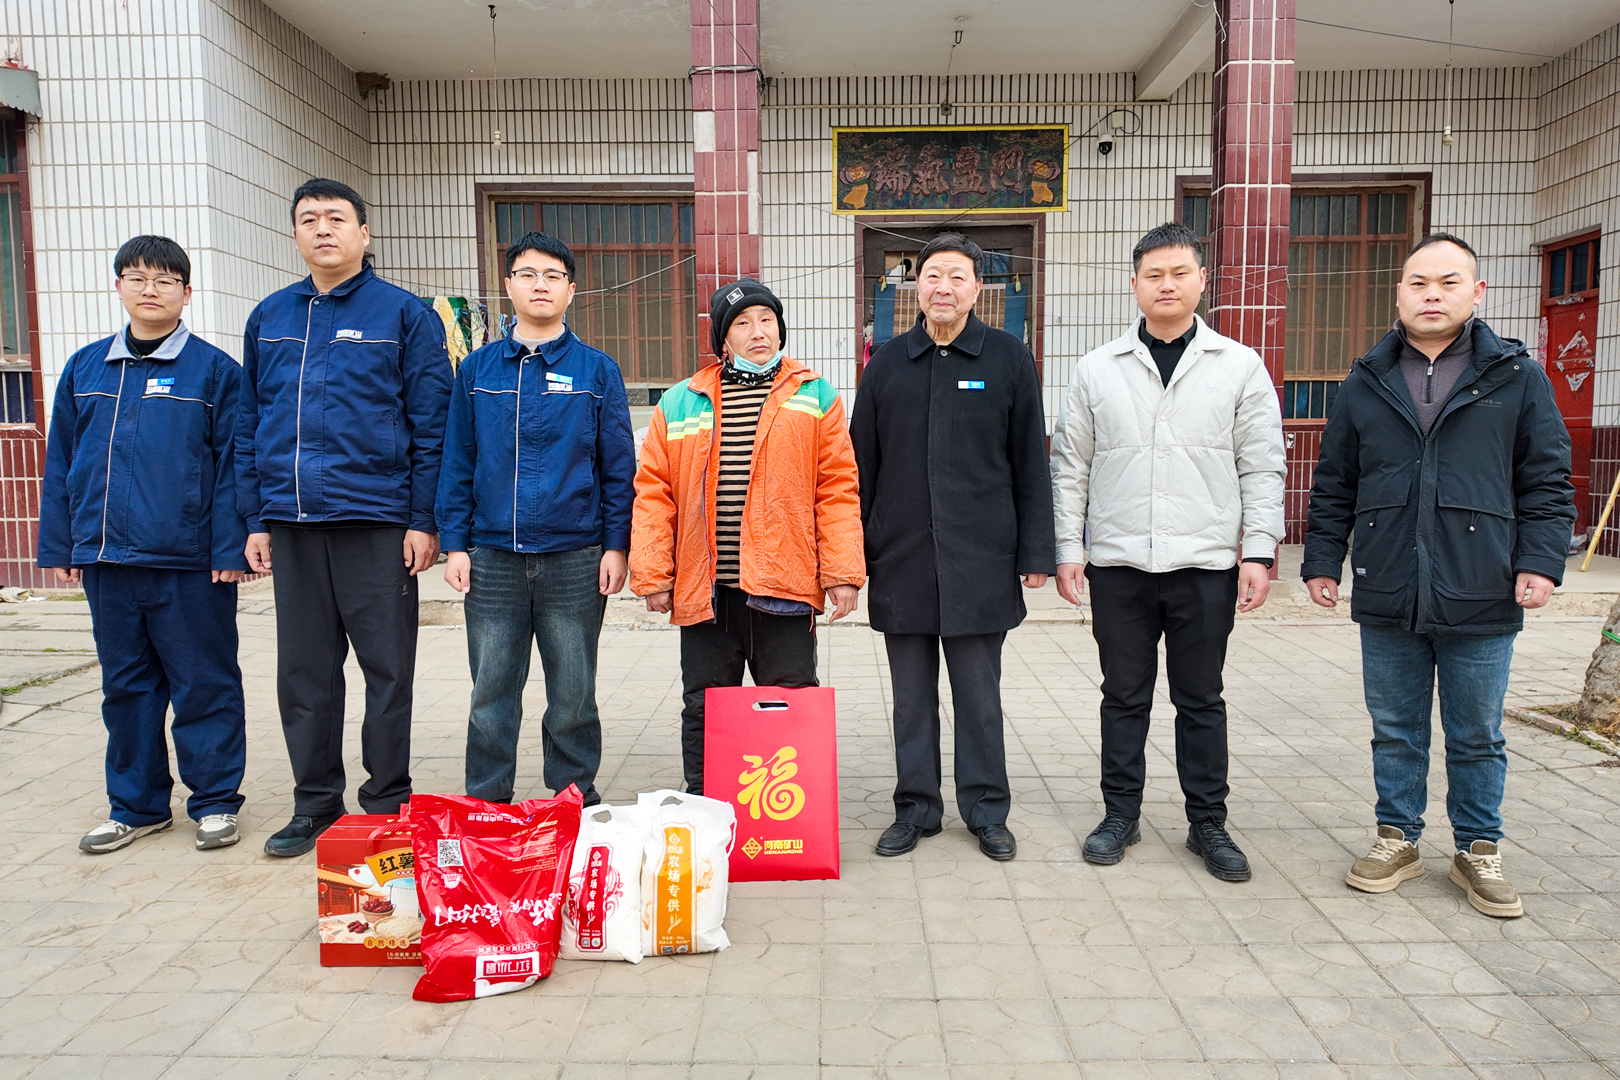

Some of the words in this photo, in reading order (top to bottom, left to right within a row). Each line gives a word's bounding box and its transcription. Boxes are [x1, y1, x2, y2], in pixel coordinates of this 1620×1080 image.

[737, 746, 805, 821] 福
[764, 839, 803, 850] 河南矿山
[586, 868, 599, 911] 农场专供
[667, 855, 680, 912] 农场专供
[367, 939, 407, 947] 自然精选
[486, 960, 530, 975] 红门小厨
